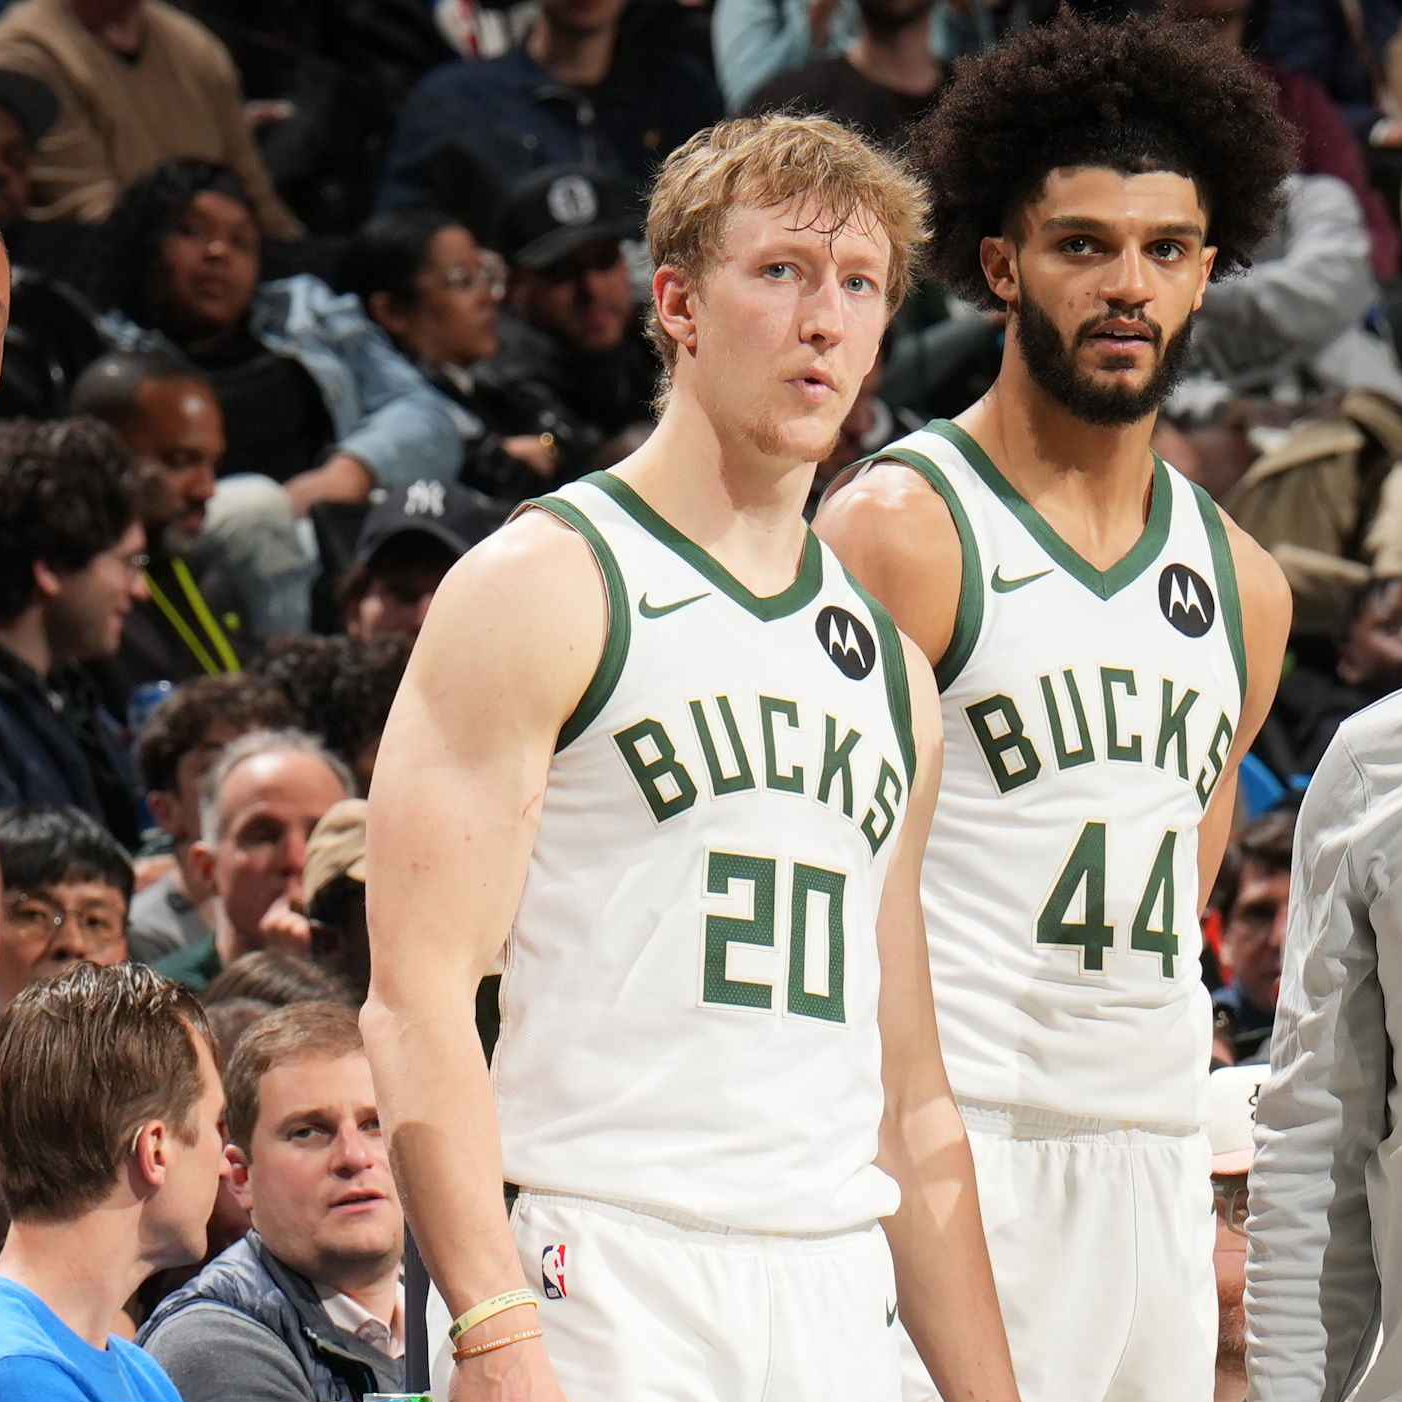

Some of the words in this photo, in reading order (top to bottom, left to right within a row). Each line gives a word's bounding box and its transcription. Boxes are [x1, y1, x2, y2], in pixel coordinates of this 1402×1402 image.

[610, 693, 903, 861] BUCKS
[963, 665, 1234, 812] BUCKS
[701, 850, 848, 1025] 20
[1035, 821, 1180, 979] 44
